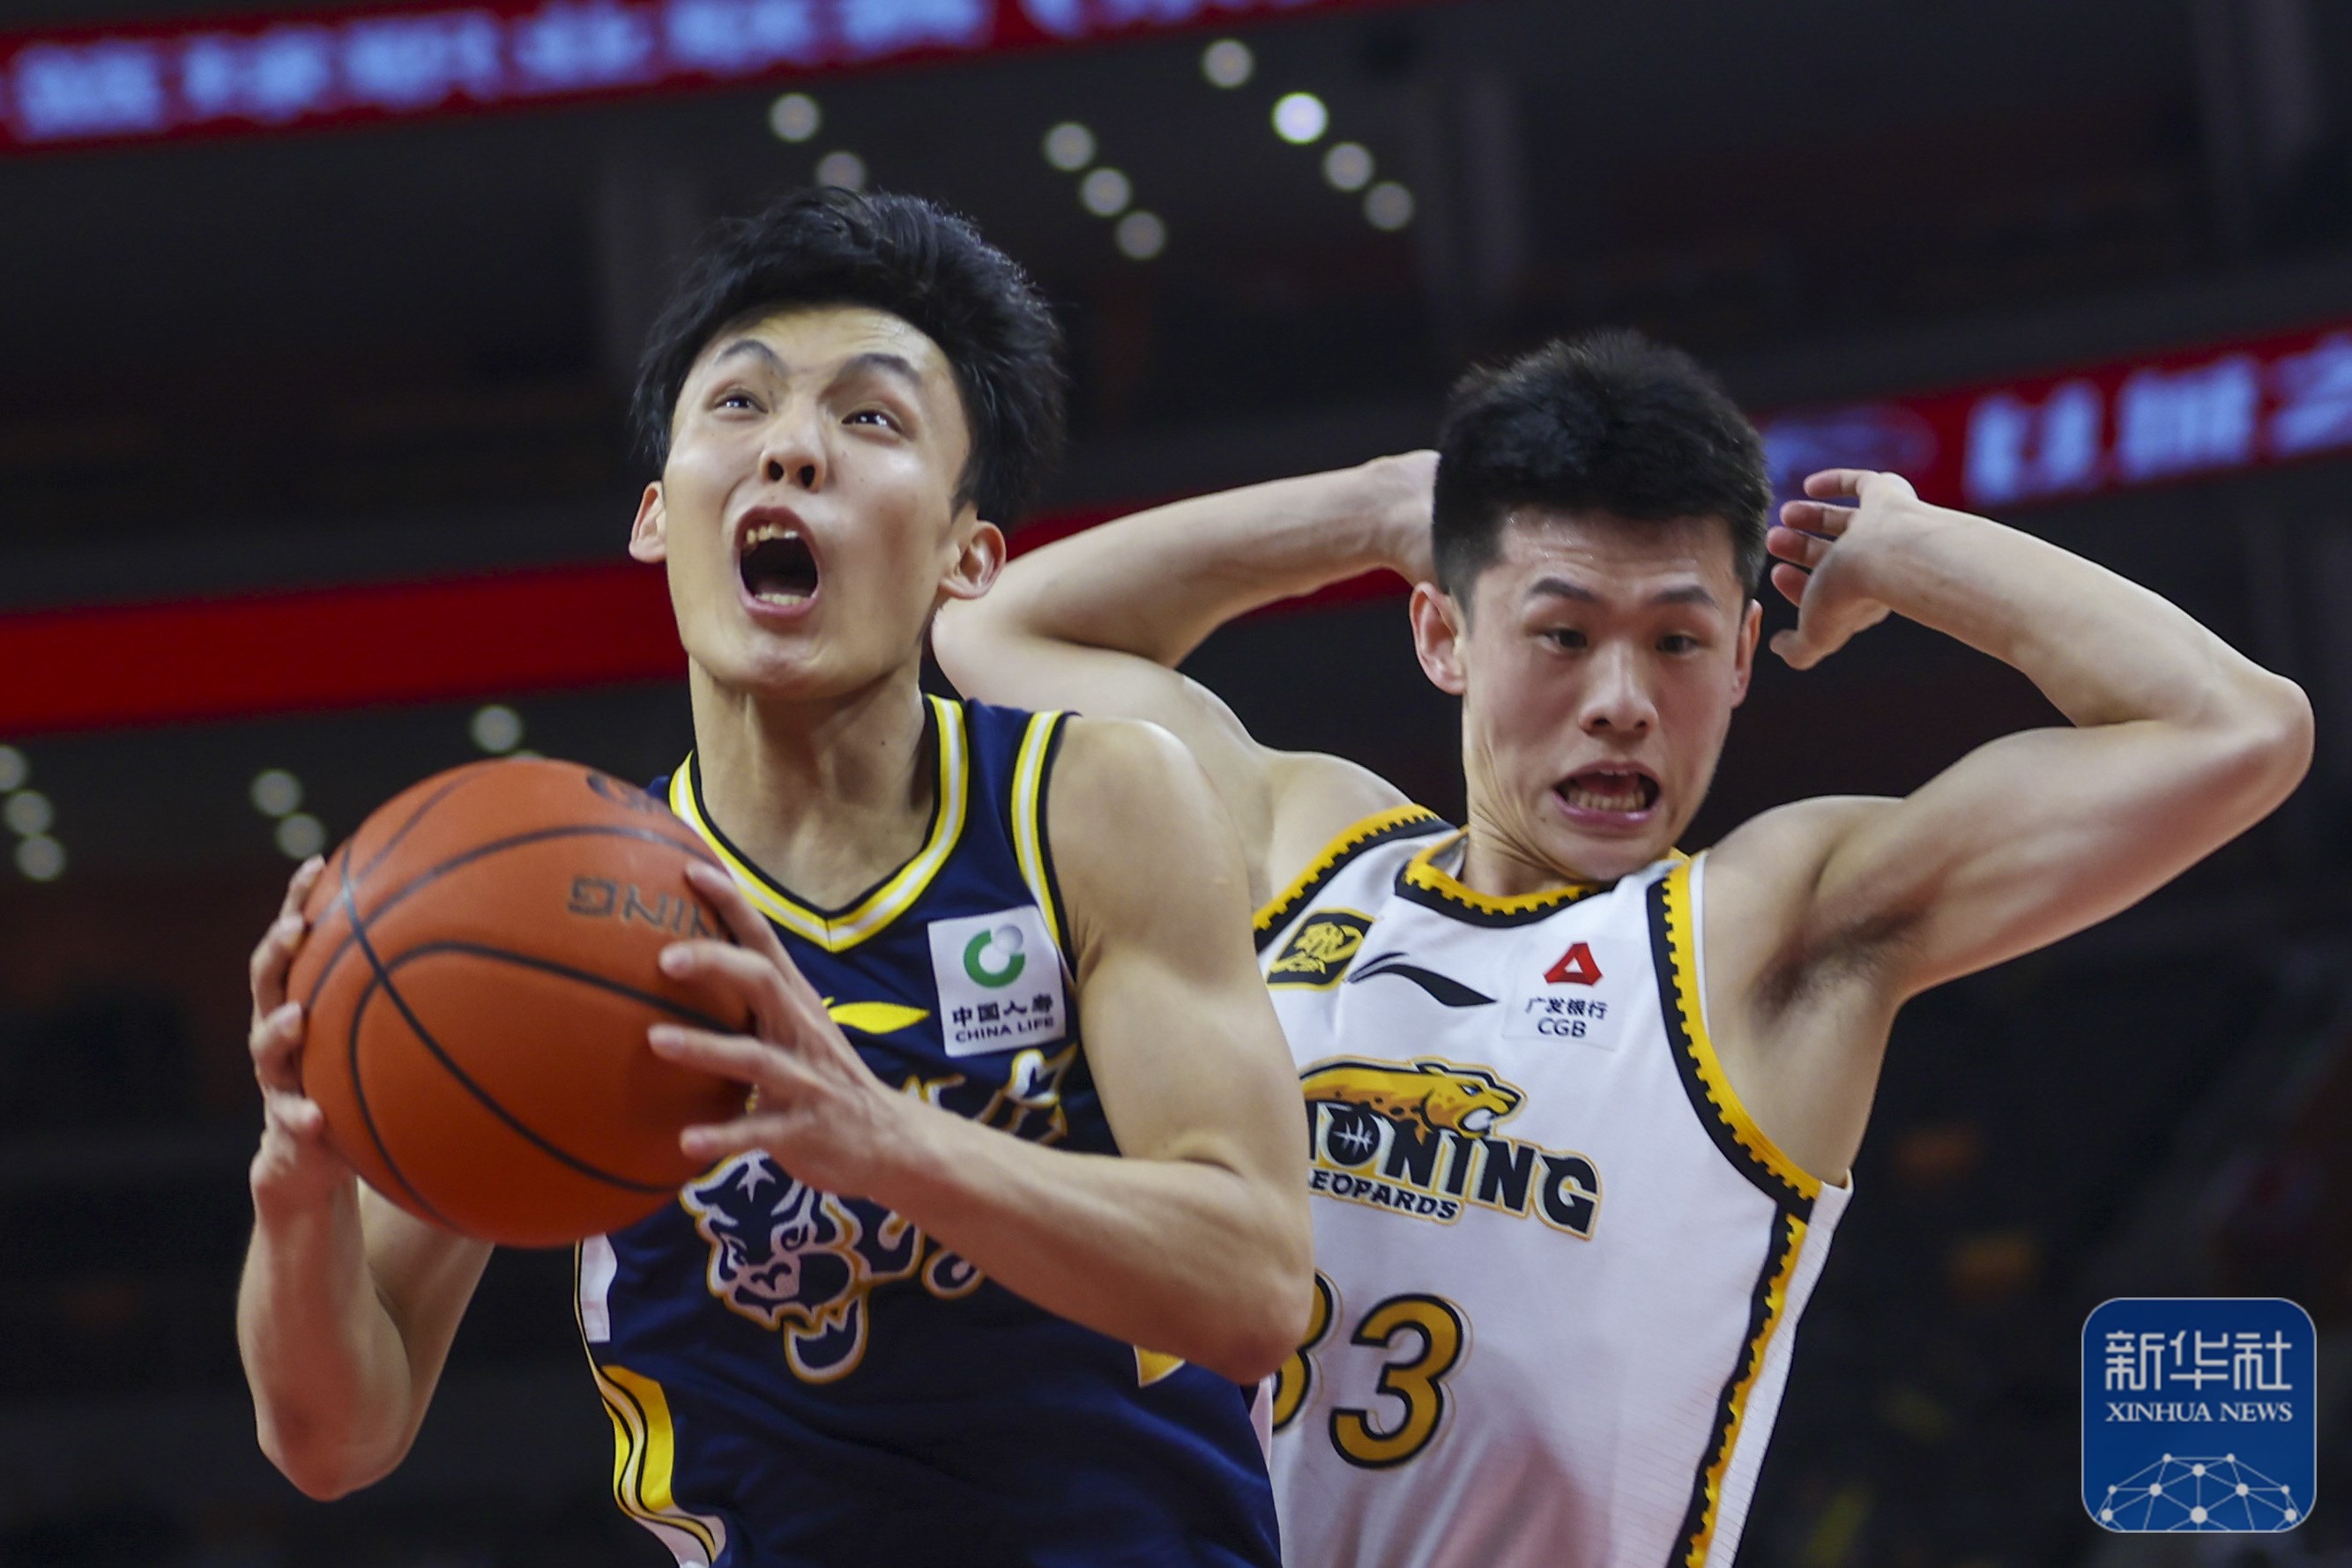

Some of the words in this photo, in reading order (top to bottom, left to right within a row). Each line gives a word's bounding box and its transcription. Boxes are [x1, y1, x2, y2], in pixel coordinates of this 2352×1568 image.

[952, 993, 1053, 1028] 中国人寿
[1525, 997, 1608, 1020] 广发银行
[955, 1025, 1012, 1043] CHINA
[1016, 1017, 1054, 1033] LIFE
[1537, 1016, 1587, 1037] CGB
[1306, 1099, 1599, 1235] ONING
[1309, 1168, 1460, 1220] EOPARDS
